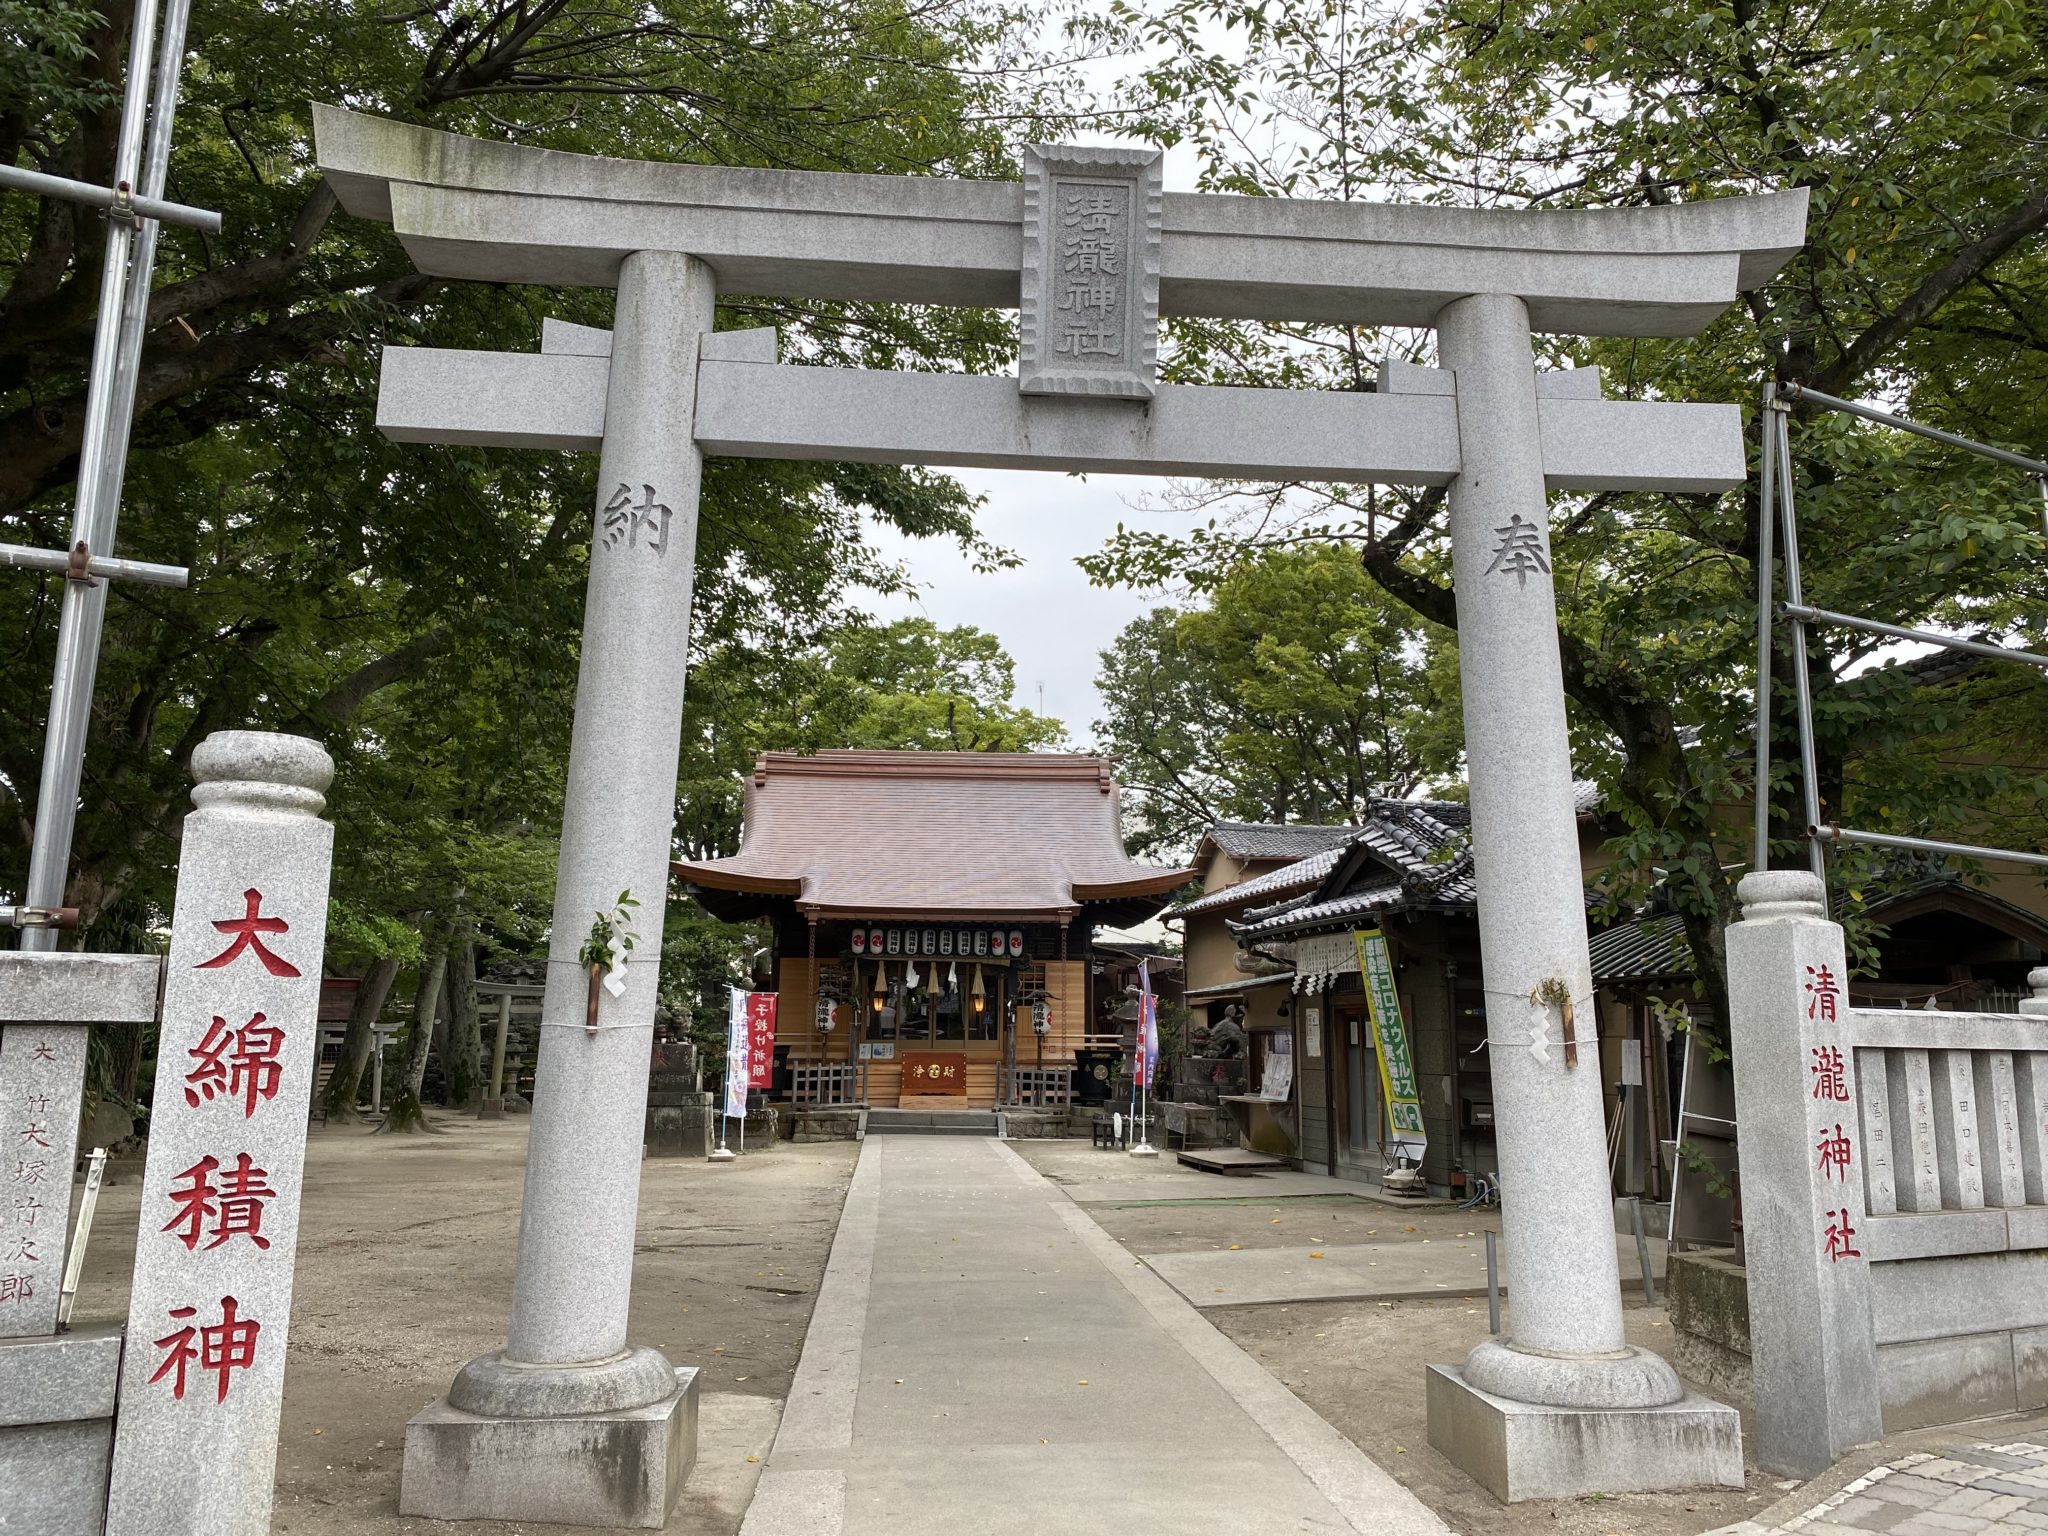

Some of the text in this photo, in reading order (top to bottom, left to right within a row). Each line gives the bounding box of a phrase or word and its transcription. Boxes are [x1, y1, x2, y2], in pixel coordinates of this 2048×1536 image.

[1056, 191, 1121, 358] 清瀧神社
[601, 482, 673, 559] 納
[1483, 513, 1551, 591] 奉
[1374, 937, 1416, 1097] 新型コロナウイルス
[147, 887, 302, 1405] 大綿積神
[1804, 963, 1861, 1264] 清瀧神社
